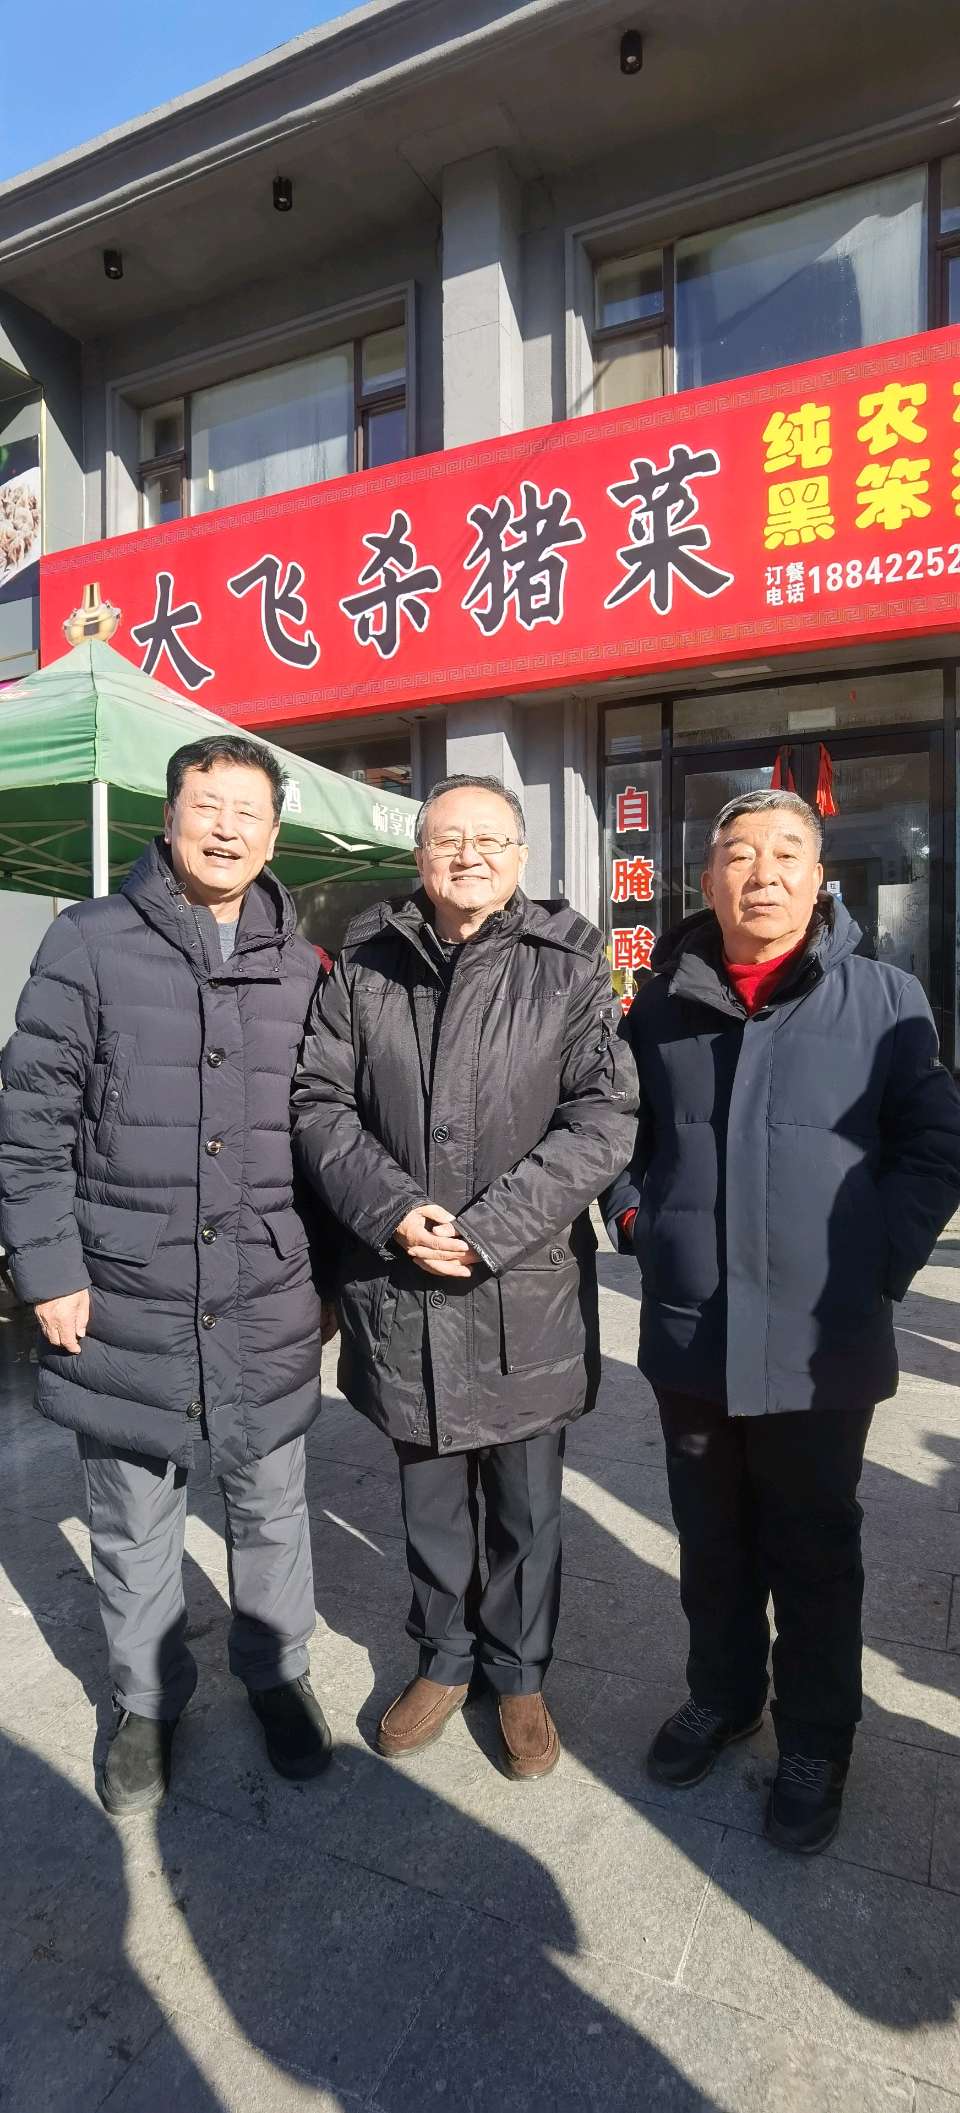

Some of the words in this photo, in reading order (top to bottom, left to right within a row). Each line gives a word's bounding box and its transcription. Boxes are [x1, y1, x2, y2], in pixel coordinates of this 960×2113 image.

[762, 382, 960, 473] 纯农
[763, 448, 960, 550] 黑笨
[130, 445, 734, 690] 大飞杀猪菜
[765, 562, 805, 586] 订餐
[808, 543, 960, 594] 18842252
[766, 584, 806, 607] 电话
[611, 786, 655, 1017] 自腌酸
